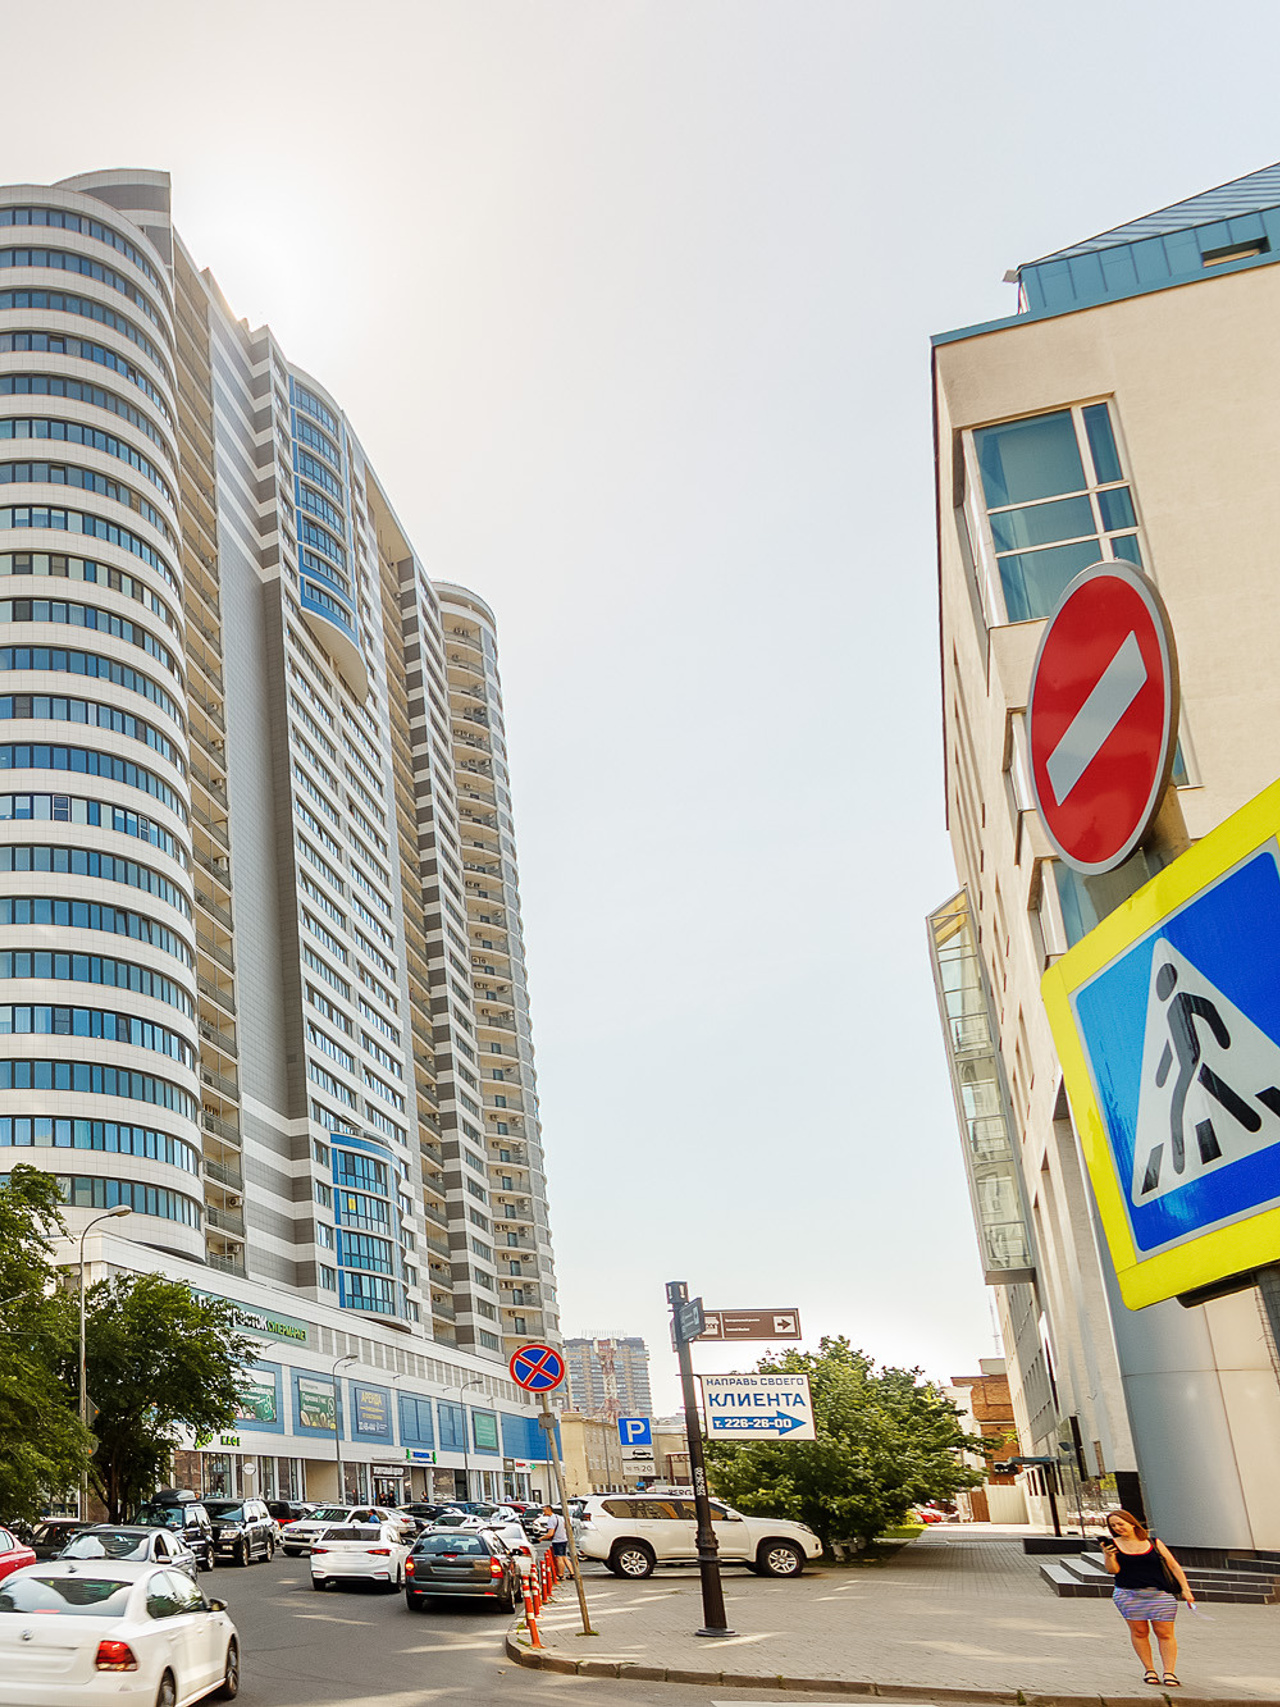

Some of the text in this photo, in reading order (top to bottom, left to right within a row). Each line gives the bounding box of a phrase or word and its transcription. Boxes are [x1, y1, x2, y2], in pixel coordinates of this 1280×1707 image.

[706, 1377, 804, 1386] НАПРАВЬ СВОЕГО
[708, 1393, 806, 1407] КЛИЕНТА
[724, 1418, 793, 1428] 226-26-00
